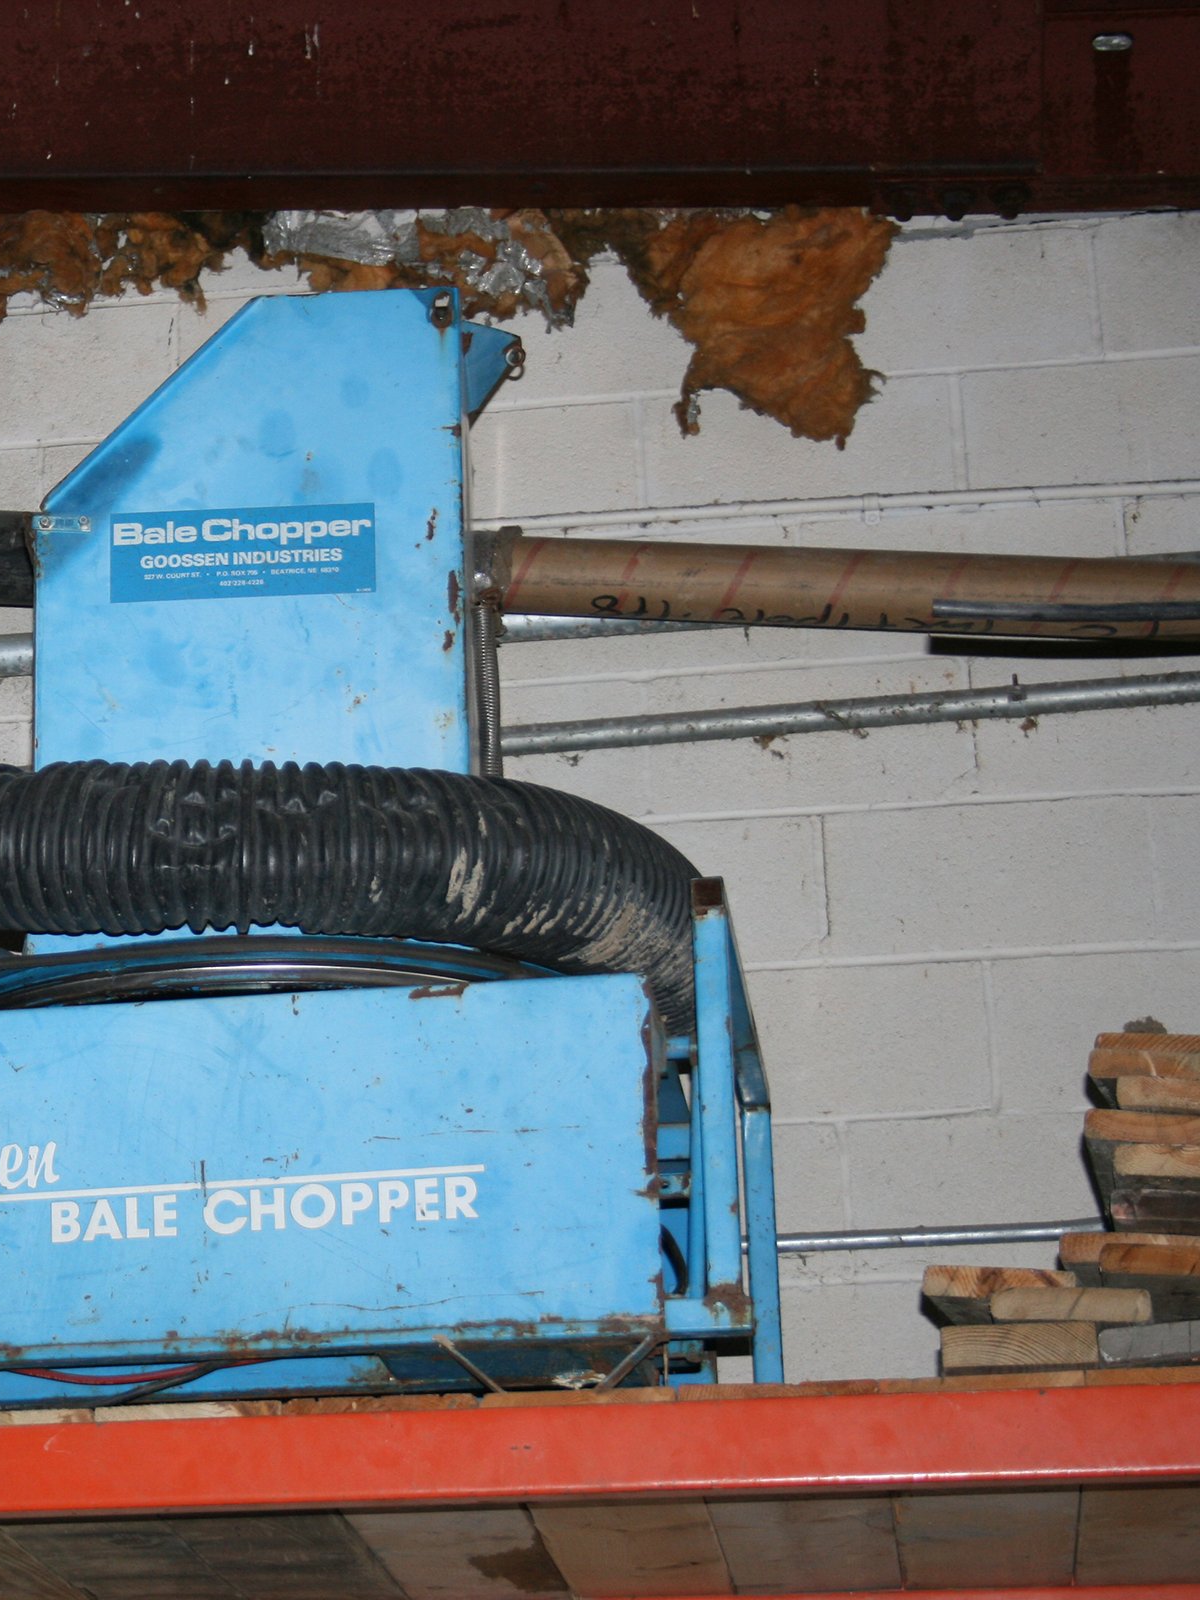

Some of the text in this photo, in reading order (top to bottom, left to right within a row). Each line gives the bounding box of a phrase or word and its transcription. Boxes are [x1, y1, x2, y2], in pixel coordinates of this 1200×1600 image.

[113, 518, 372, 546] Bale Chopper
[140, 548, 344, 569] GOOSSEN INDUSTRIES
[51, 1176, 479, 1244] BALE CHOPPER
